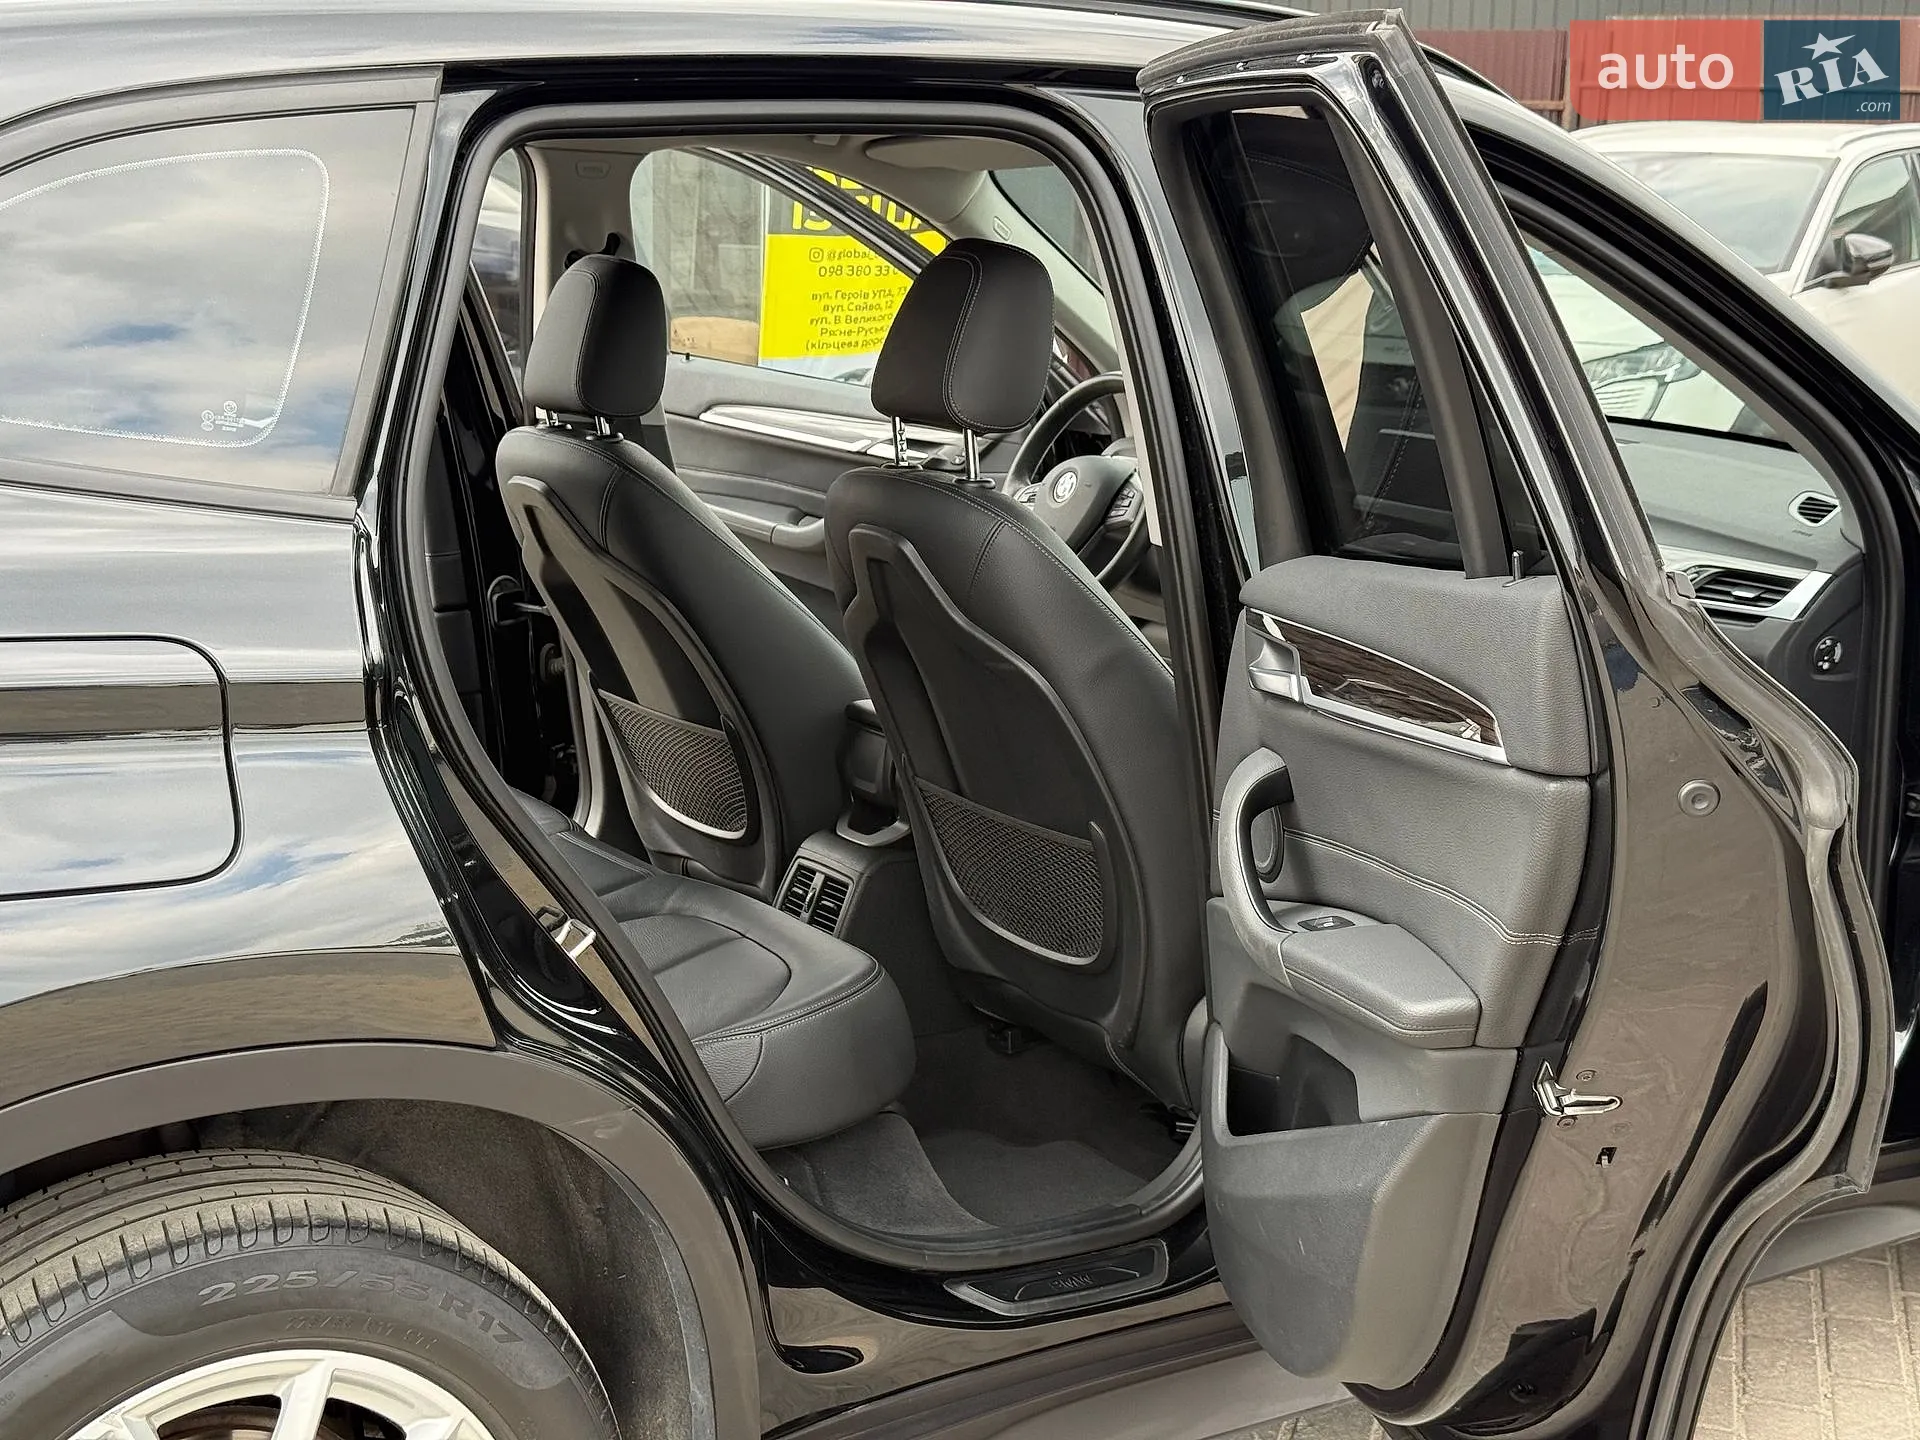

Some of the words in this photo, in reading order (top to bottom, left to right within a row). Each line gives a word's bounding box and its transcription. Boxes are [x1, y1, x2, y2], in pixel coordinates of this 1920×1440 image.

[818, 265, 843, 278] 098
[874, 265, 890, 277] 33
[198, 1270, 430, 1306] 225/55
[438, 1291, 524, 1344] R17
